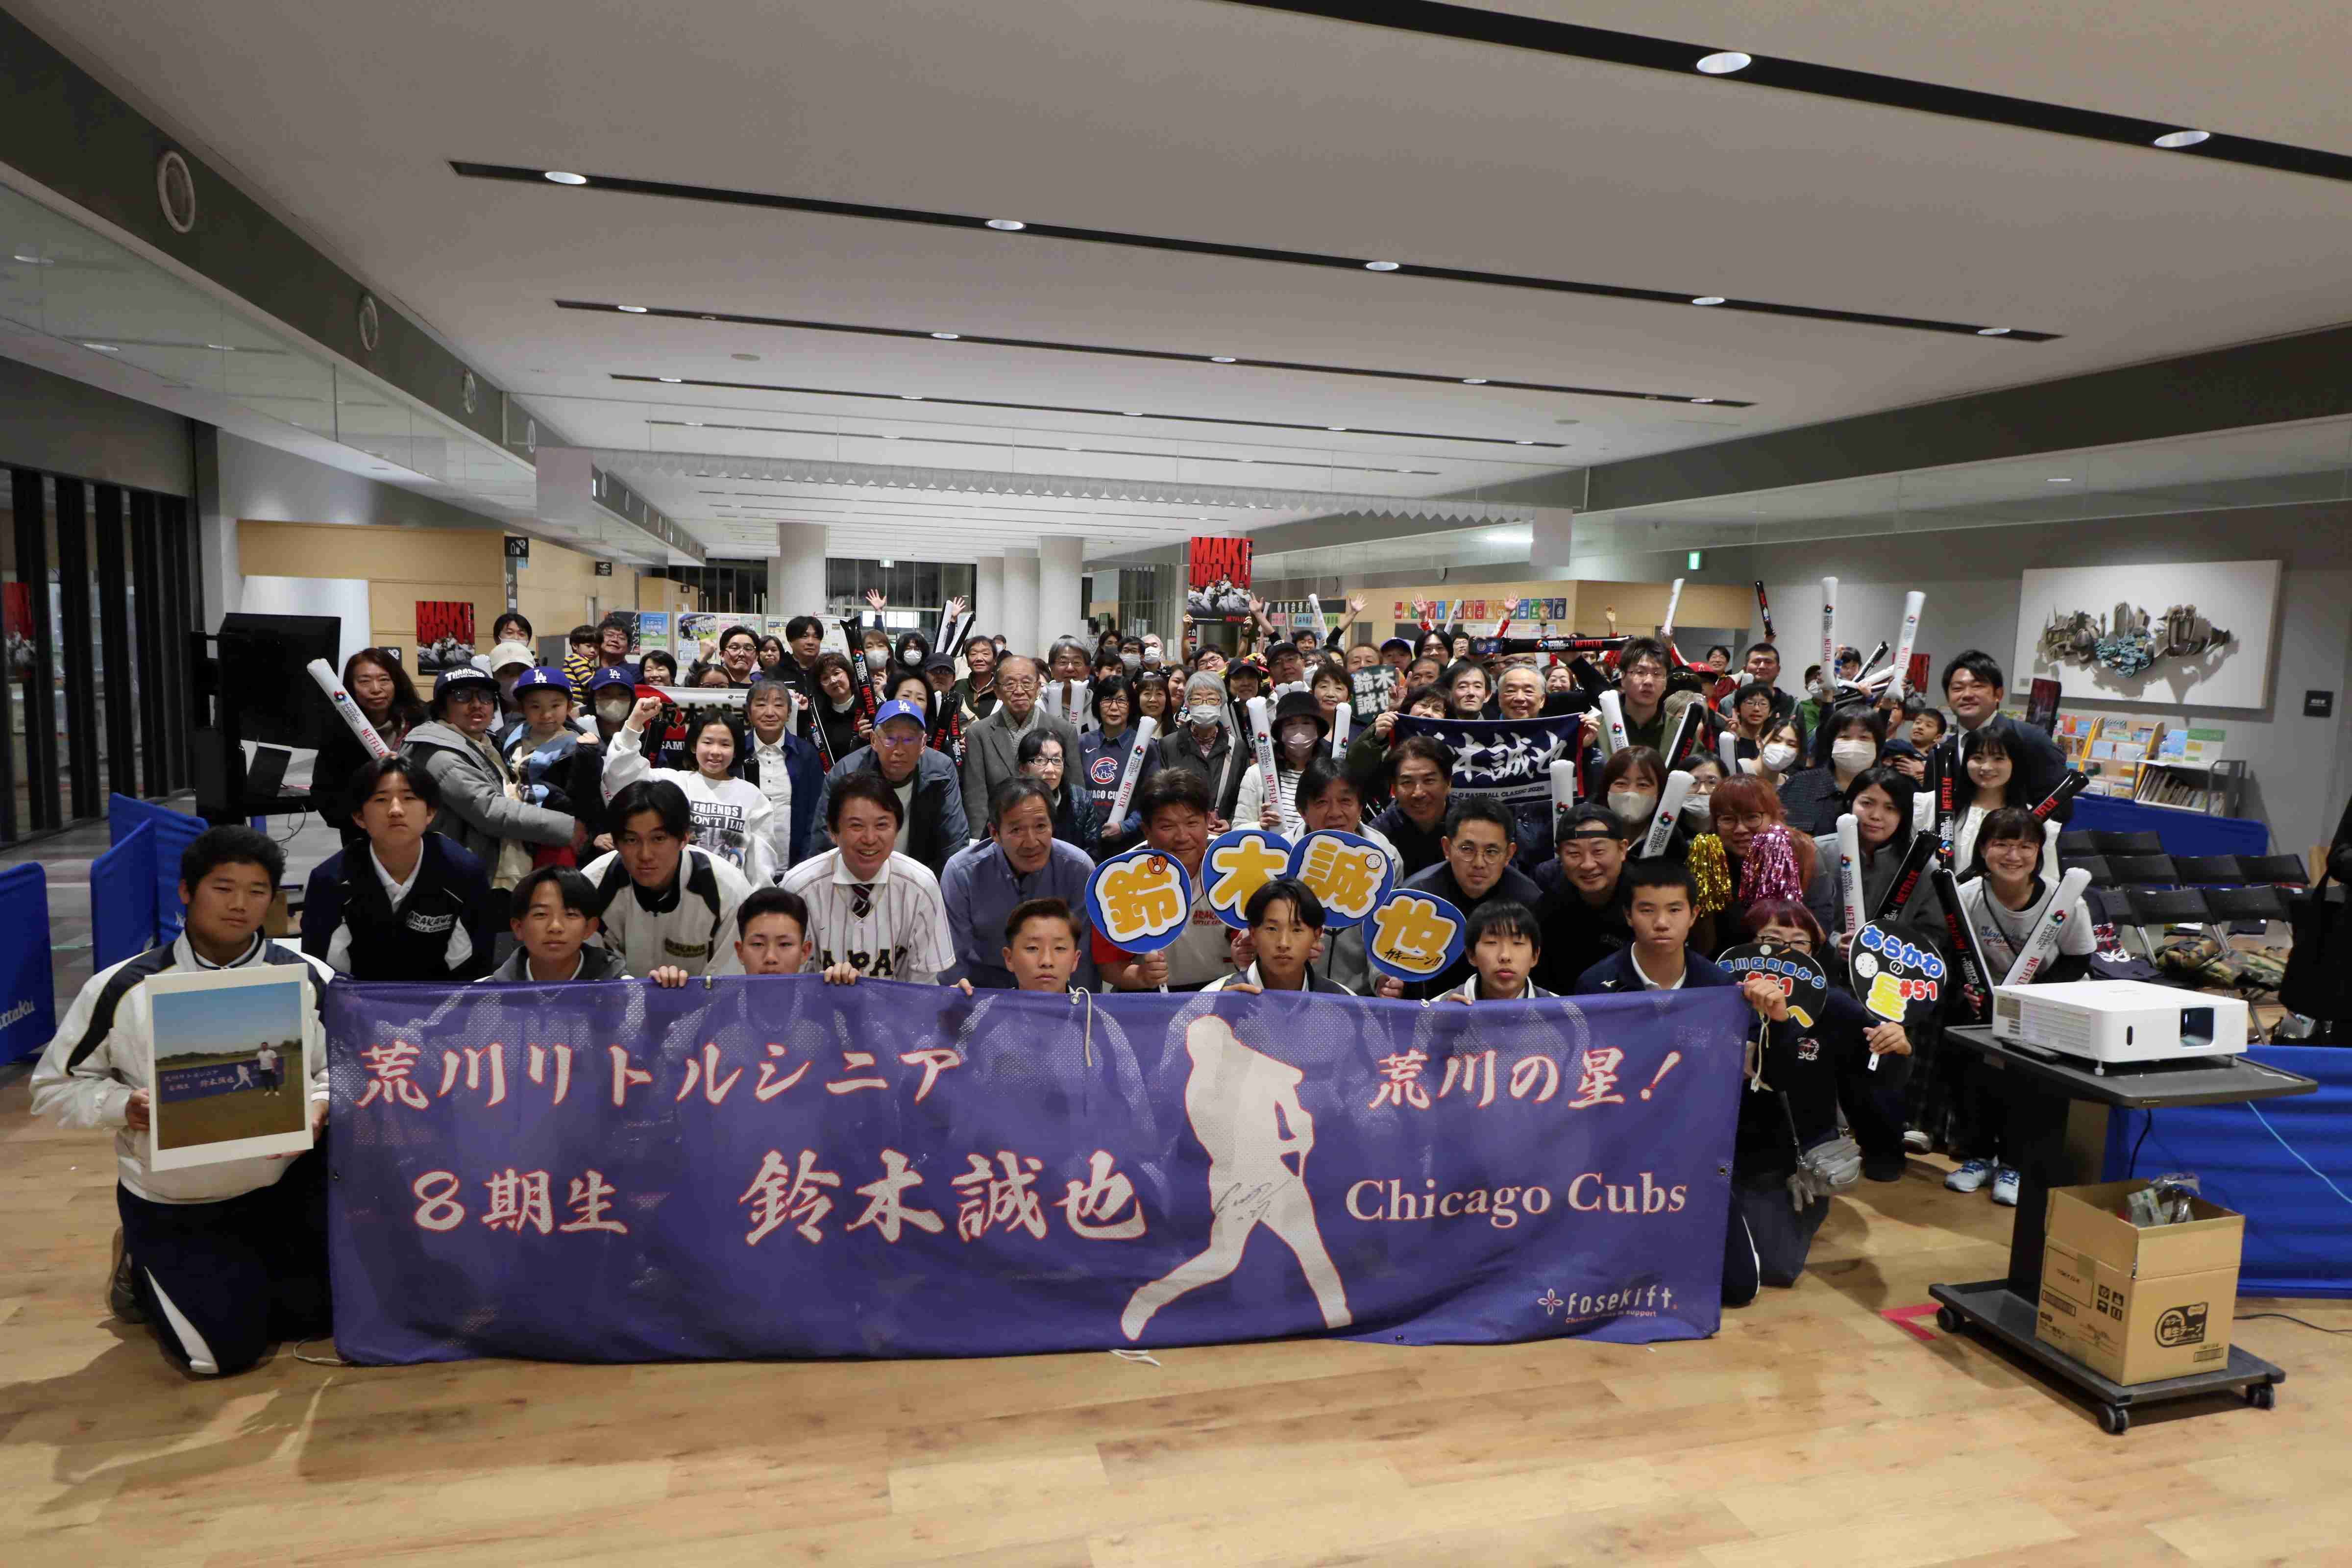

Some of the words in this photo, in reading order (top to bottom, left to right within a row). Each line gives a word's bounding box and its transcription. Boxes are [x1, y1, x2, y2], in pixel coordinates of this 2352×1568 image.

[1191, 537, 1253, 564] MAKE
[1822, 638, 1832, 662] NETFLIX
[534, 669, 548, 683] LA
[609, 669, 621, 679] LA
[1354, 669, 1396, 693] 鈴木
[862, 686, 876, 714] NETFLIX
[898, 700, 910, 712] LA
[361, 728, 385, 758] NETFLIX
[1118, 781, 1132, 808] NETFLIX
[1265, 774, 1278, 804] NETFLIX
[1941, 776, 1953, 809] NETFLIX
[693, 803, 739, 816] FRIENDS
[1648, 827, 1659, 848] CLASSIC
[1651, 828, 1663, 853] BASEBALL
[1660, 830, 1668, 848] WORLD
[1214, 840, 1286, 920] 木
[1302, 841, 1375, 912] 誠
[1894, 870, 1921, 904] NETFLIX
[1103, 862, 1179, 934] 鈴
[1375, 899, 1456, 971] 也
[1861, 925, 1944, 978] あらかわ
[1890, 960, 1904, 975] の
[1866, 972, 1907, 1022] 星
[1899, 979, 1937, 1001] #51
[355, 1040, 962, 1110] 荒川リトルシニア
[410, 1167, 629, 1237] 8期生
[738, 1149, 1148, 1247] 鈴木誠也
[1346, 1178, 1553, 1229] Chicago
[1568, 1172, 1689, 1215] Cubs
[1626, 1309, 1658, 1318] support
